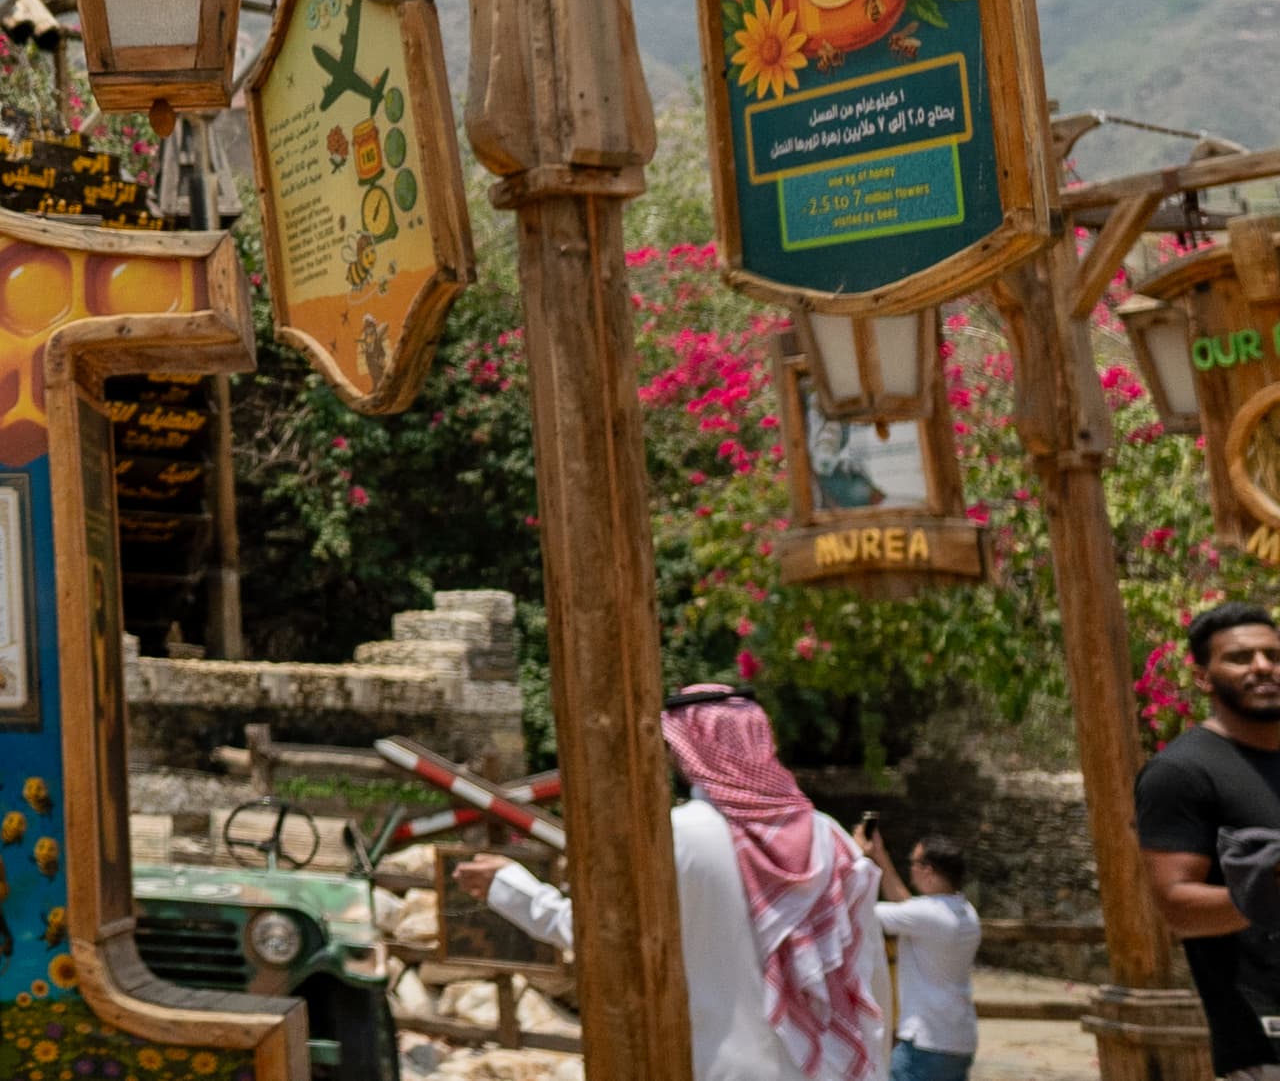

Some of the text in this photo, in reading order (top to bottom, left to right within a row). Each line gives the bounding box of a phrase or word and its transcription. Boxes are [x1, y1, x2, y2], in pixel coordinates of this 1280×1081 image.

[834, 195, 849, 210] to
[852, 189, 861, 207] 7
[1193, 329, 1263, 370] OUR
